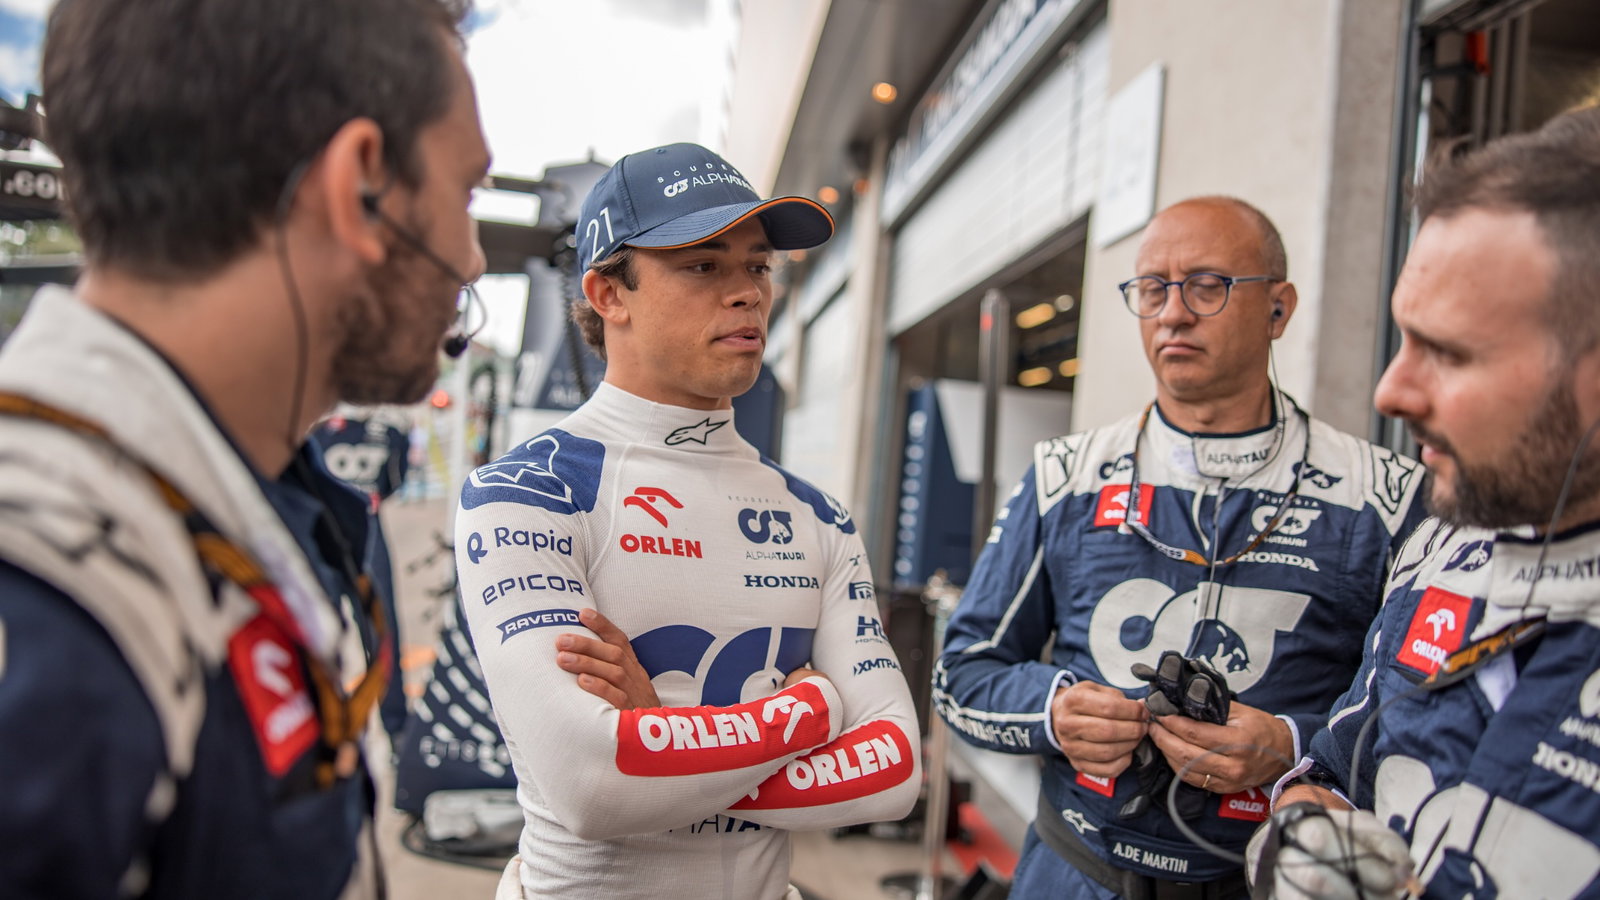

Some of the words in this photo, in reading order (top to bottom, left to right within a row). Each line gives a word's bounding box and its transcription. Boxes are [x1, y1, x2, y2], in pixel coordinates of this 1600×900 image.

[585, 206, 616, 262] 21
[494, 526, 572, 557] Rapid
[620, 533, 703, 559] ORLEN
[746, 551, 805, 561] ALPHATAURI
[1237, 551, 1320, 572] HONDA
[743, 574, 820, 590] HONDA
[504, 613, 580, 634] RAVENO
[638, 712, 760, 752] ORLEN
[786, 734, 901, 790] ORLEN
[1229, 800, 1264, 813] ORLEN
[1113, 842, 1140, 862] A.DE
[1142, 851, 1188, 873] MARTIN
